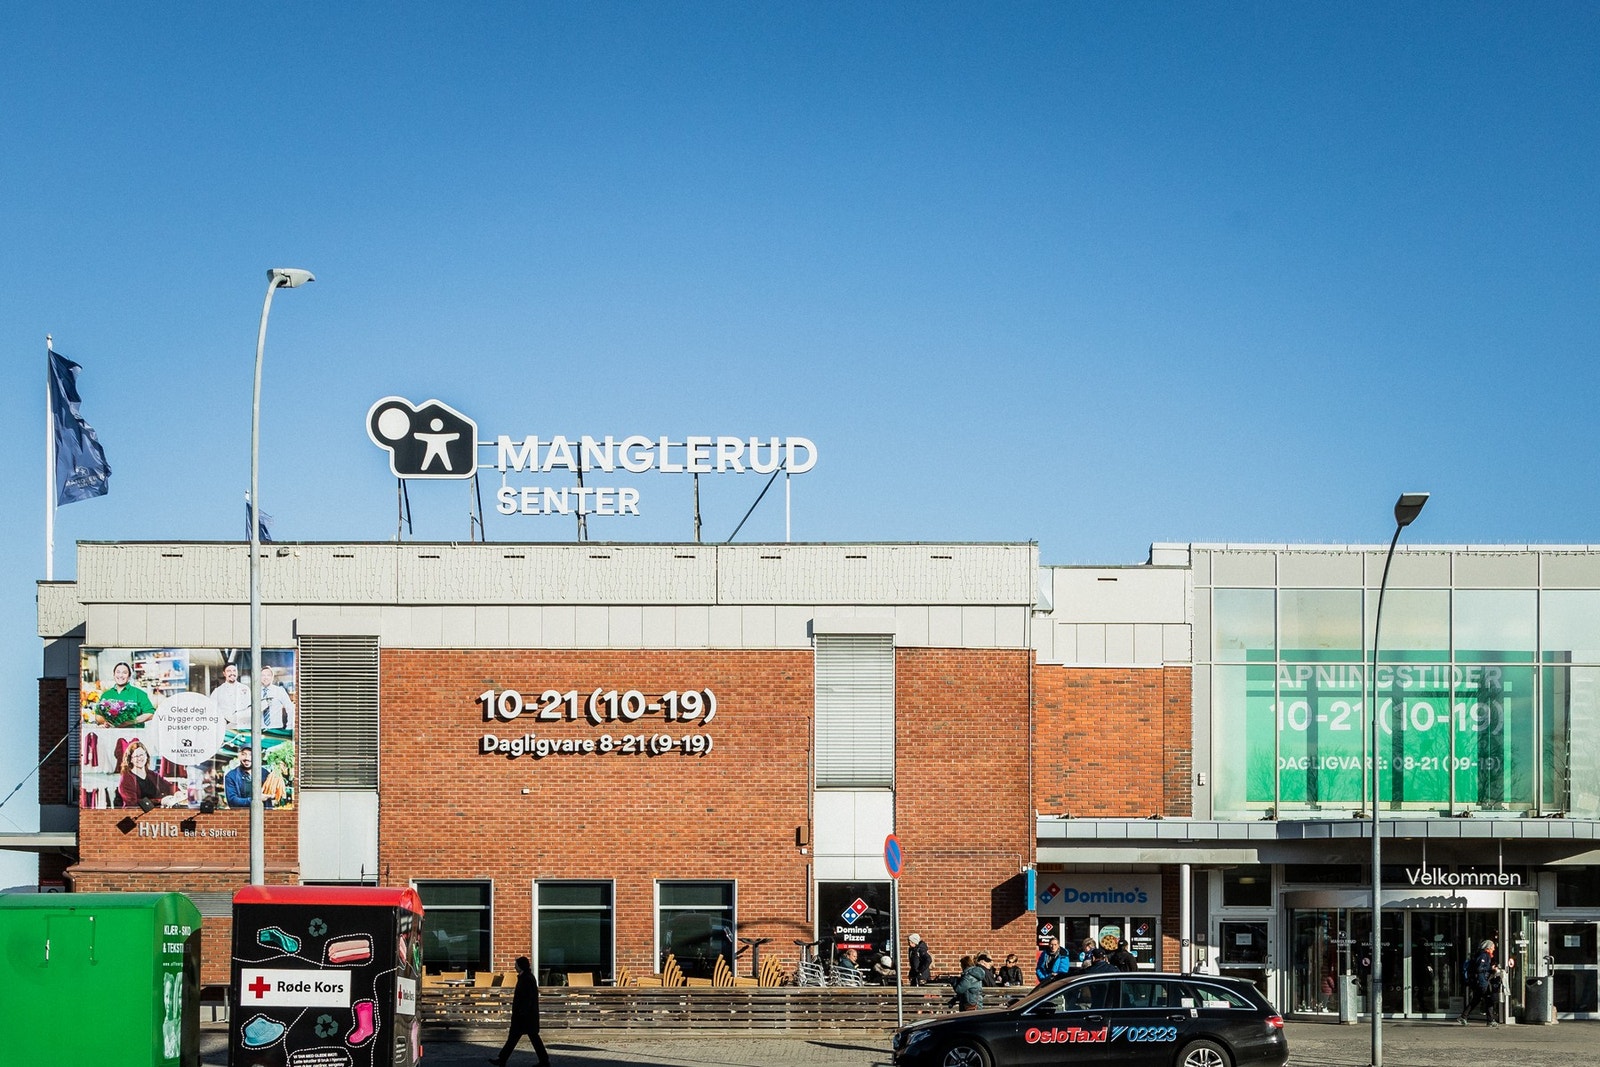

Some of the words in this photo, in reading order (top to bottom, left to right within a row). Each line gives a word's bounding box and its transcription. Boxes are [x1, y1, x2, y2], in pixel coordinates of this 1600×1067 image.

[498, 435, 818, 474] MANGLERUD
[497, 486, 640, 516] SENTER
[1272, 659, 1502, 688] ÅPNINGSTIDER
[190, 706, 207, 715] deg!
[479, 689, 578, 719] 10-21
[589, 688, 717, 724] (10-19)
[168, 715, 194, 723] bygger
[1269, 701, 1364, 731] 10-21
[1379, 698, 1504, 735] (10-19)
[483, 734, 595, 757] Dagligvare
[600, 734, 645, 752] 8-21
[650, 733, 714, 755] (9-19)
[1393, 756, 1439, 771] 08-21
[1442, 755, 1501, 772] (09-19)
[139, 822, 178, 838] Hylla
[184, 829, 198, 837] Bar
[200, 829, 207, 837] &
[209, 828, 238, 837] Spiseri
[1405, 867, 1521, 886] Velkommen
[1064, 887, 1148, 903] Domino's
[836, 926, 872, 934] Domino's
[277, 981, 311, 993] Røde
[315, 981, 344, 993] Kors
[1025, 1026, 1108, 1043] OsloTaxi
[1127, 1026, 1178, 1042] 02323
